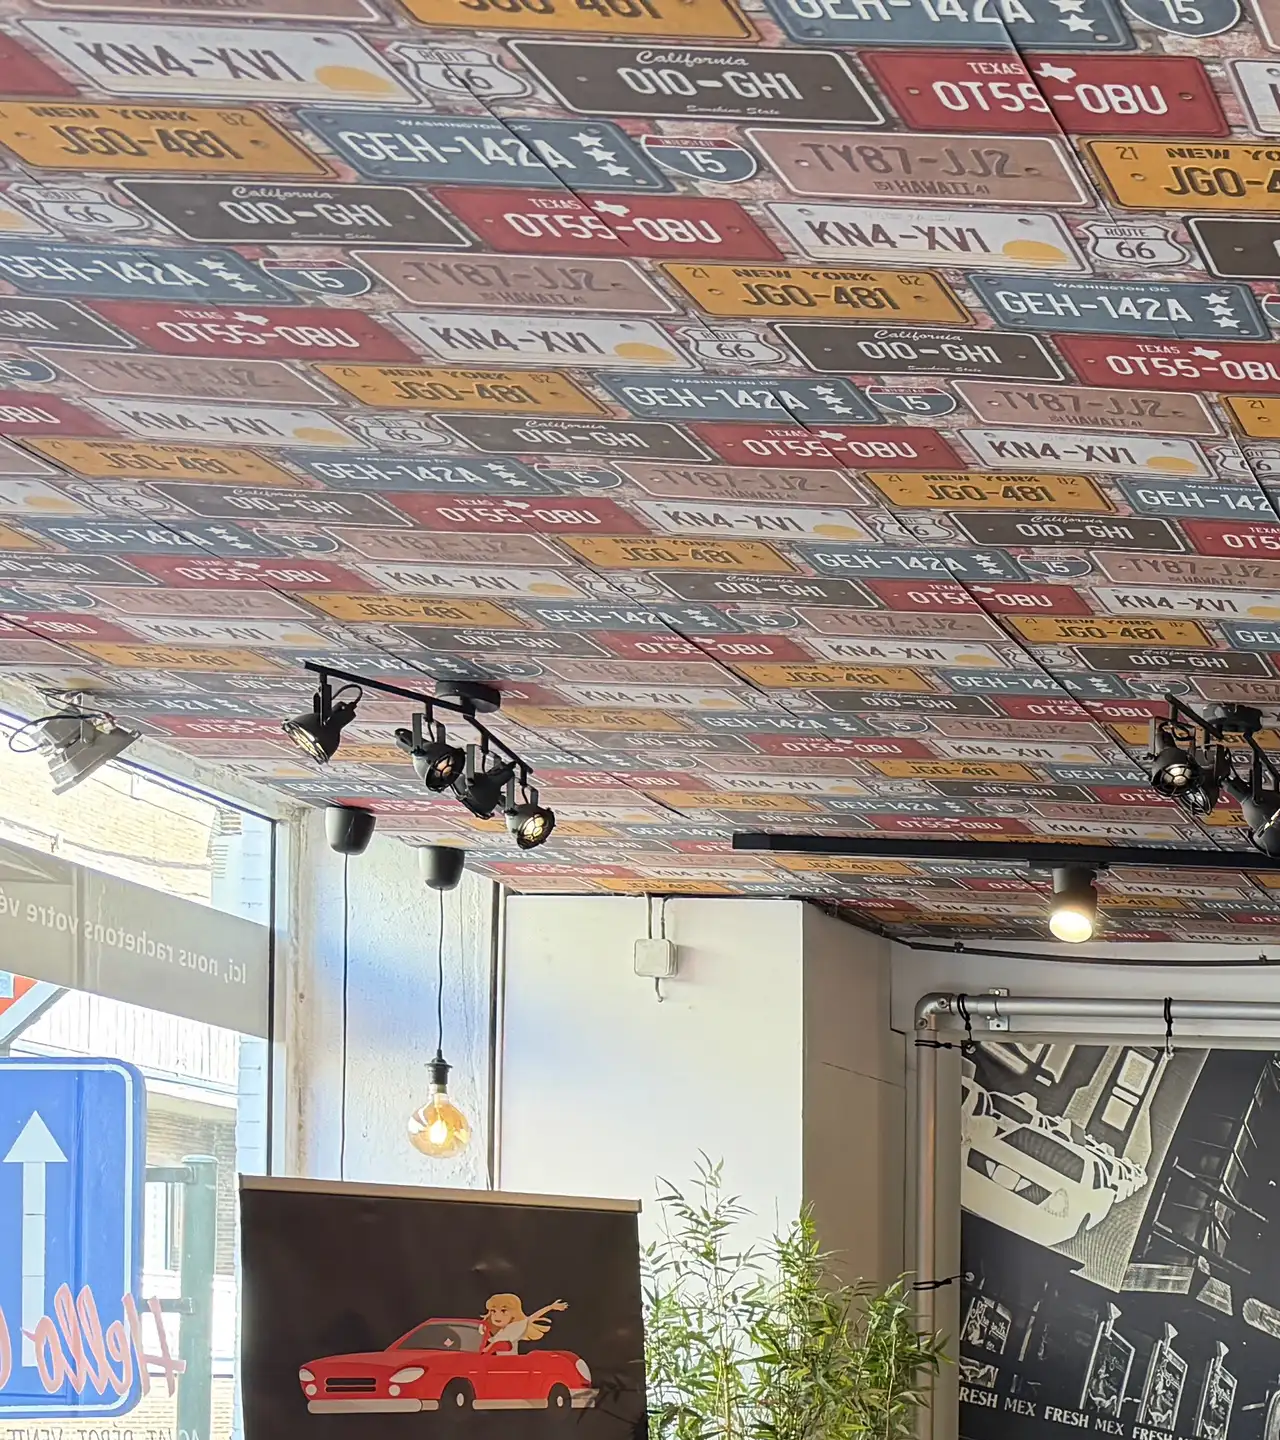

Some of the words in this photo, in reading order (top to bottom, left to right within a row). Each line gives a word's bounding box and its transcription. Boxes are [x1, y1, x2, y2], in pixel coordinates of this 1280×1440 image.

[635, 51, 751, 69] California
[966, 61, 1024, 77] TEXAS
[28, 106, 105, 121] NEW
[117, 109, 198, 124] YORK
[348, 131, 577, 171] GEH-142A
[686, 149, 724, 174] 15
[1165, 146, 1234, 162] NEW
[527, 199, 582, 212] TEXAS
[301, 269, 336, 290] 15
[994, 288, 1195, 326] GEH-142A
[309, 456, 484, 485] GEH-142A
[44, 524, 208, 548] GEH-142A
[959, 1387, 999, 1409] RESH
[1004, 1399, 1036, 1417] MEX
[1044, 1406, 1089, 1429] FRESH
[1095, 1419, 1125, 1436] MEX
